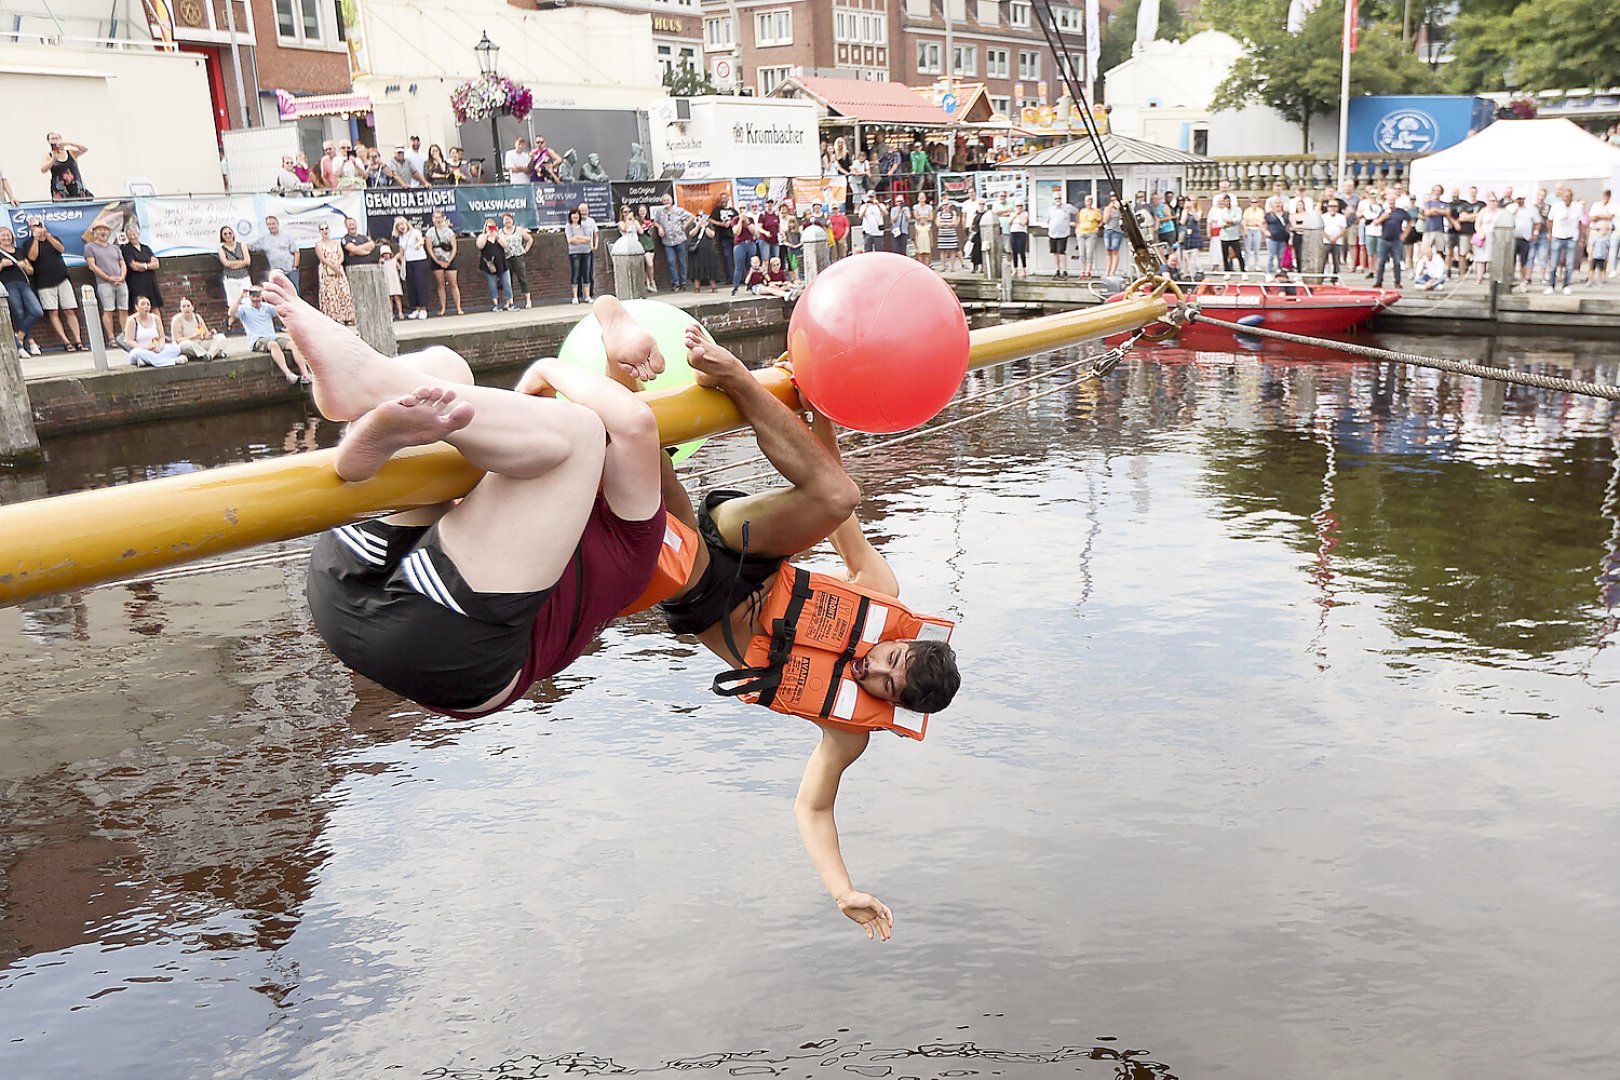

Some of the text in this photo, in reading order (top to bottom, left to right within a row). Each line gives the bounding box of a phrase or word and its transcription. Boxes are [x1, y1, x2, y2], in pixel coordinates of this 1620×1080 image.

[654, 17, 682, 32] HUUS
[745, 122, 804, 145] Krombacher
[365, 189, 456, 208] GEWOBA EMDEN
[469, 198, 527, 211] VOLKSWAGEN
[826, 594, 840, 620] FRONT
[797, 656, 811, 687] AVANT
